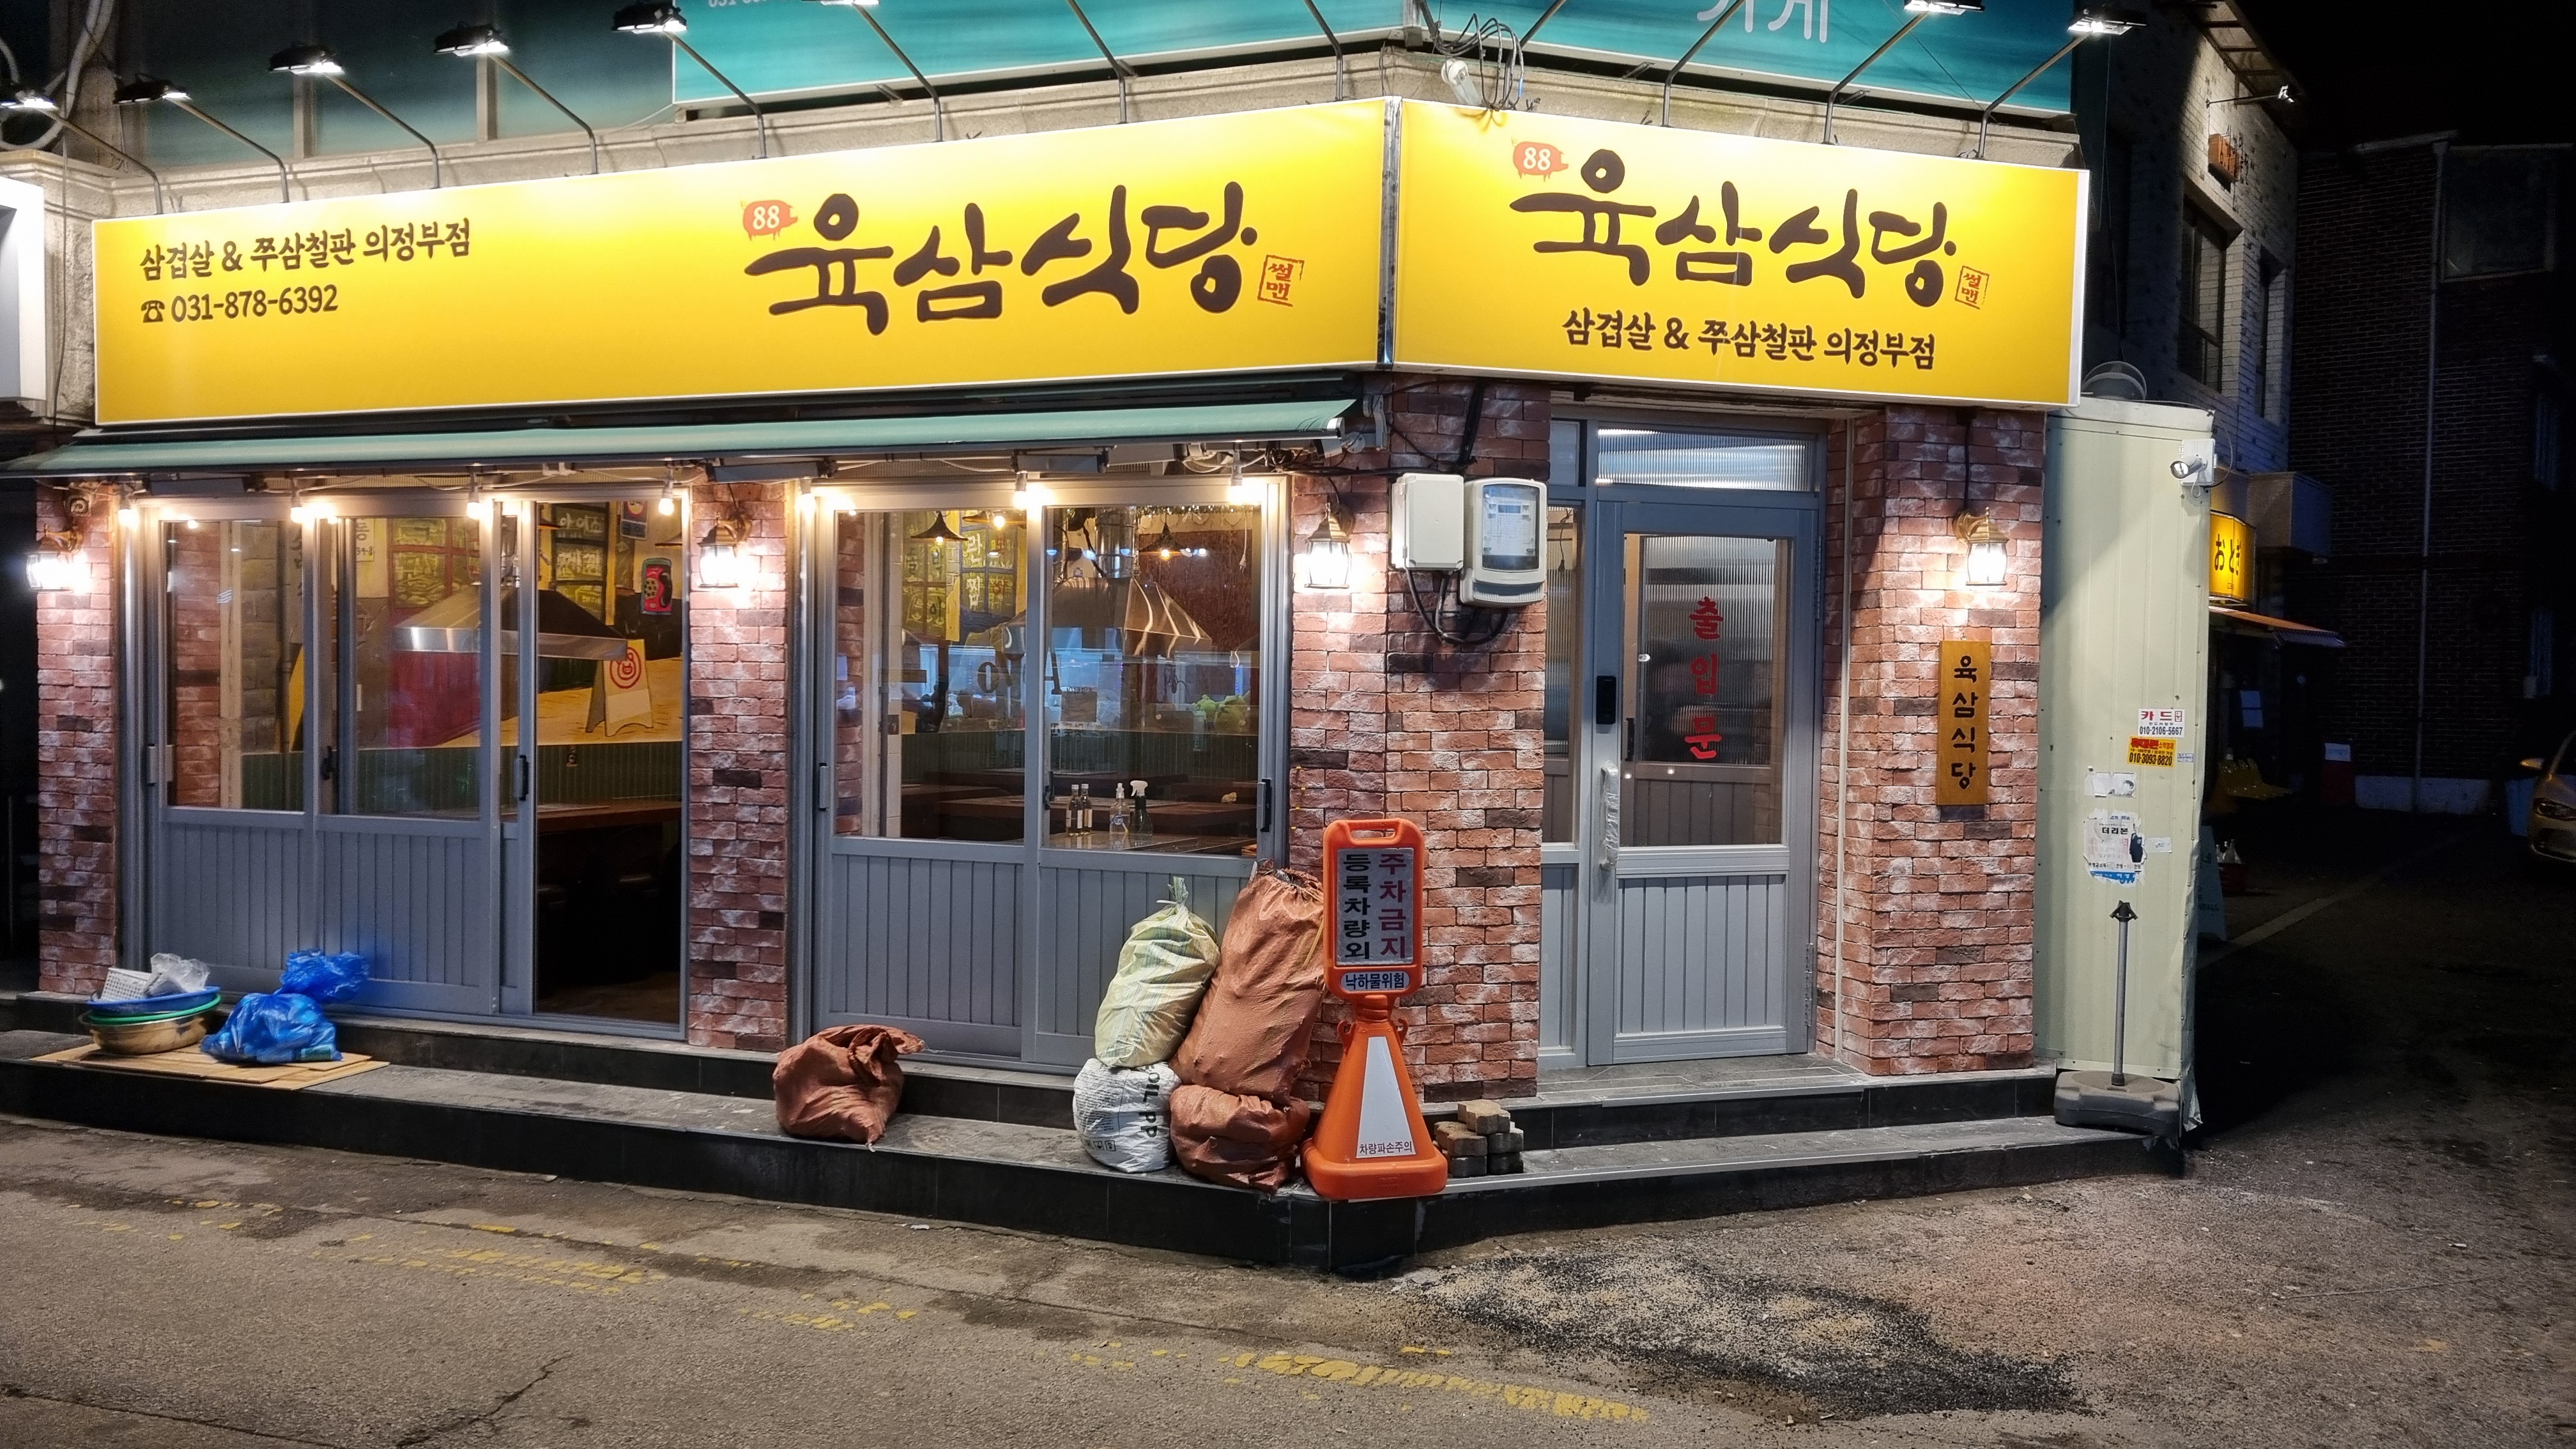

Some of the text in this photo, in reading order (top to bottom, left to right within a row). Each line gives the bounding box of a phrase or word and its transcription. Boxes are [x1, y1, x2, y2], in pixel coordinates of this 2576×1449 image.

[1522, 146, 1551, 172] 88
[752, 206, 780, 229] 88
[1510, 148, 1957, 307] 육삼식당
[140, 218, 471, 280] 삼겹살 & 쭈삼철판 의정부점
[744, 181, 1258, 335] 육삼식당
[171, 284, 339, 322] 031-878-6392
[1562, 307, 1935, 371] 삼겹살 & 쭈삼철판 의정부점
[1684, 595, 1724, 759] 출입문
[1951, 655, 1978, 790] 육삼식당
[2139, 726, 2183, 735] 010-2106-5667
[2129, 753, 2173, 766] 010-3093-8820
[1343, 854, 1371, 959] 등록차량외
[1379, 853, 1407, 958] 주차금지
[1346, 972, 1405, 990] 낙하물위험
[1359, 1140, 1413, 1154] 차량파손주의
